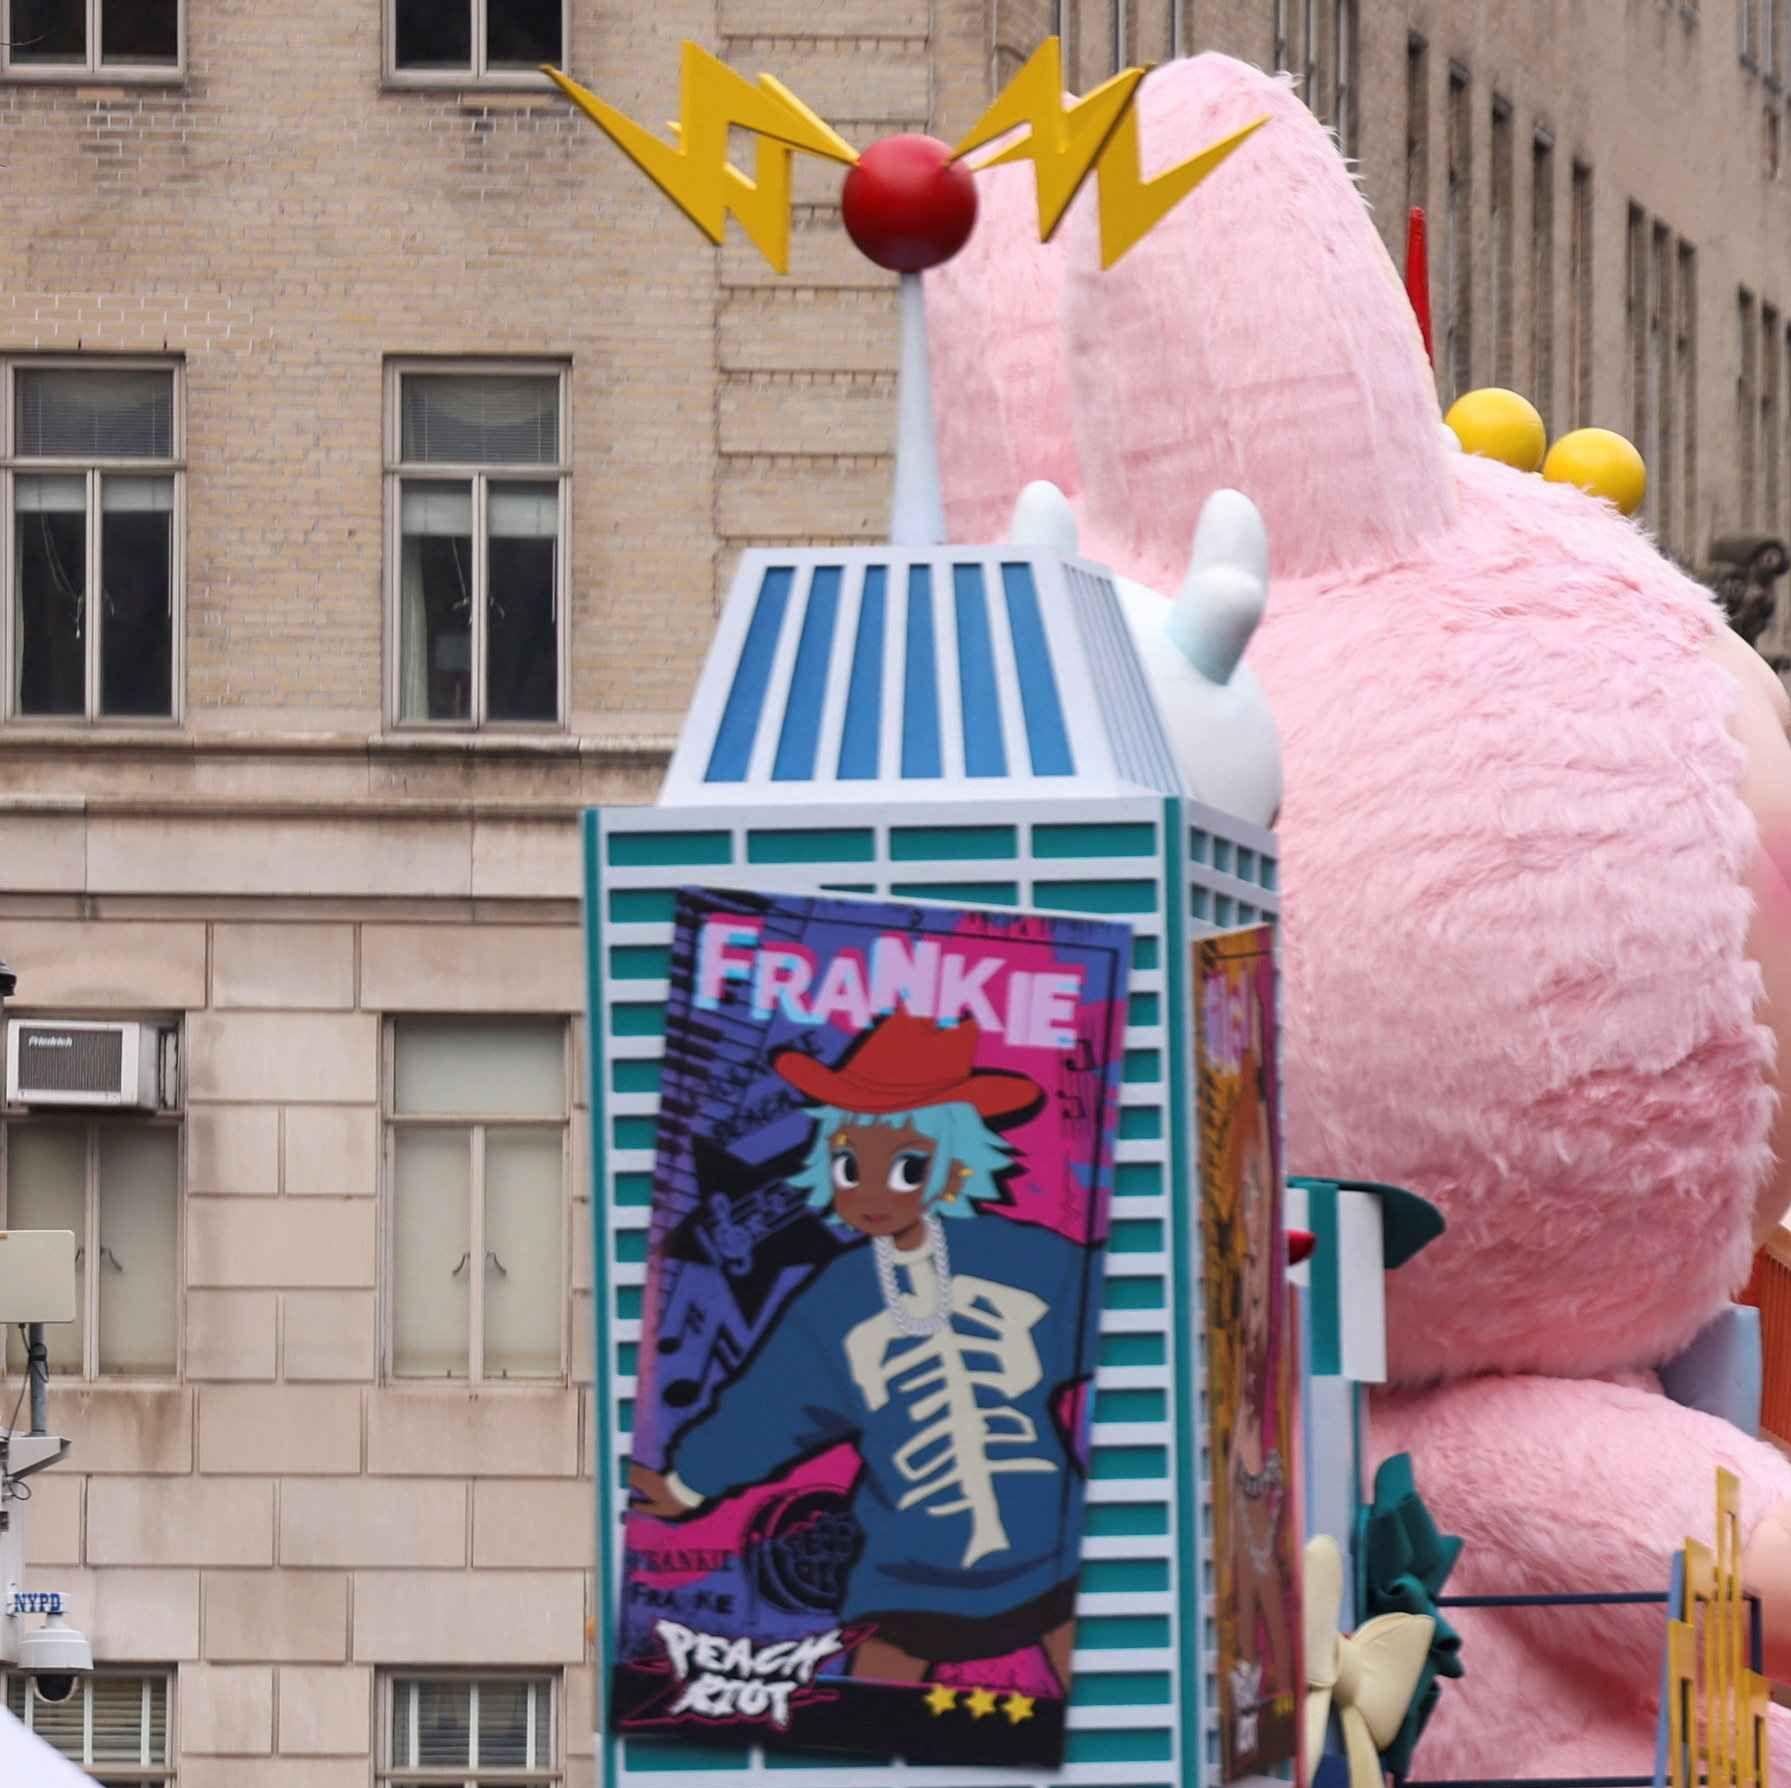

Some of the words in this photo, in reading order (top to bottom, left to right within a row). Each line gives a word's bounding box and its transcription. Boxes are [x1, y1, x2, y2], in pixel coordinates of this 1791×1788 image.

[694, 914, 1084, 1049] FRANKIE
[15, 1593, 61, 1612] NYPD
[656, 1619, 843, 1683] PEACH
[672, 1673, 798, 1726] RIOT
